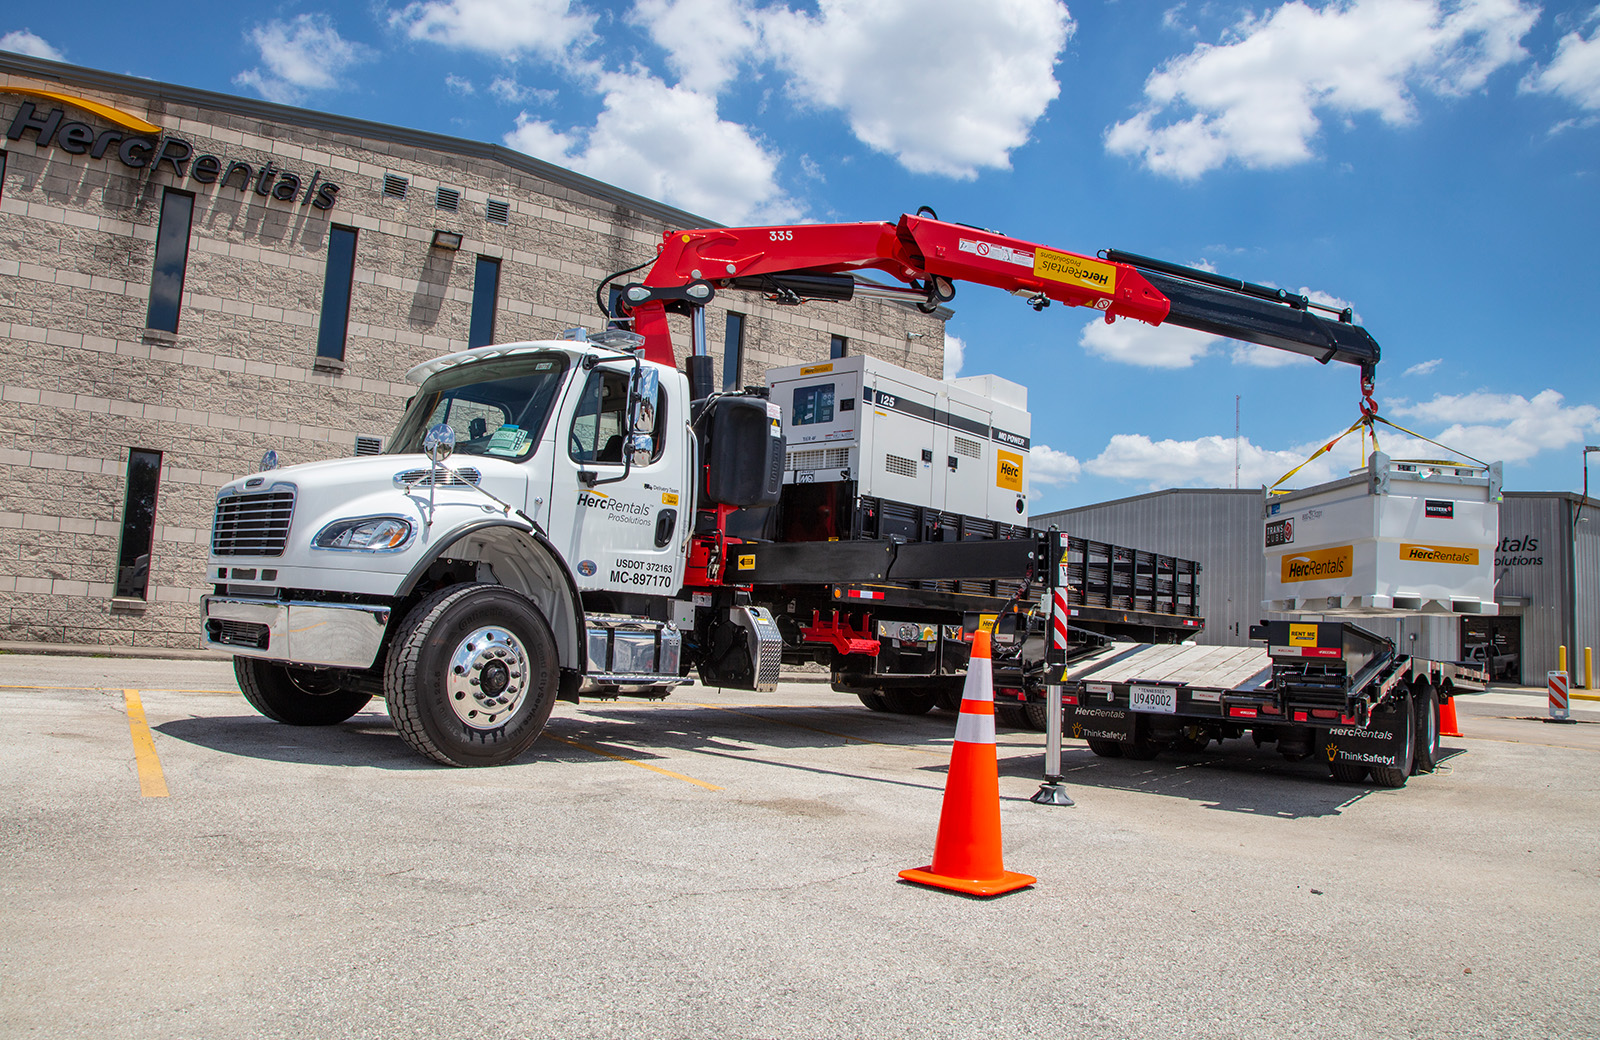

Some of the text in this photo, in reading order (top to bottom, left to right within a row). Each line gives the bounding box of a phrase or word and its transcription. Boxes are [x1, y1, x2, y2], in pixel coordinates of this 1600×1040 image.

[6, 100, 341, 210] HercRentals
[769, 230, 793, 241] 335
[1040, 251, 1082, 267] ProSolutions
[1042, 260, 1109, 285] HercRentals
[880, 394, 895, 407] 125
[998, 431, 1025, 446] MQ POWER
[1000, 463, 1019, 478] Herc
[577, 493, 651, 516] HercRentals
[608, 512, 652, 527] ProSolutions
[1267, 523, 1284, 536] TRANS
[1267, 532, 1284, 543] CUBE
[1409, 549, 1470, 563] HercRentals
[616, 558, 673, 574] USDOT 372163
[1289, 557, 1345, 578] HercRentals
[610, 570, 672, 588] MC-897170
[1134, 693, 1172, 706] U949002
[1075, 707, 1126, 719] HercRentals
[1329, 727, 1394, 740] HercRentals
